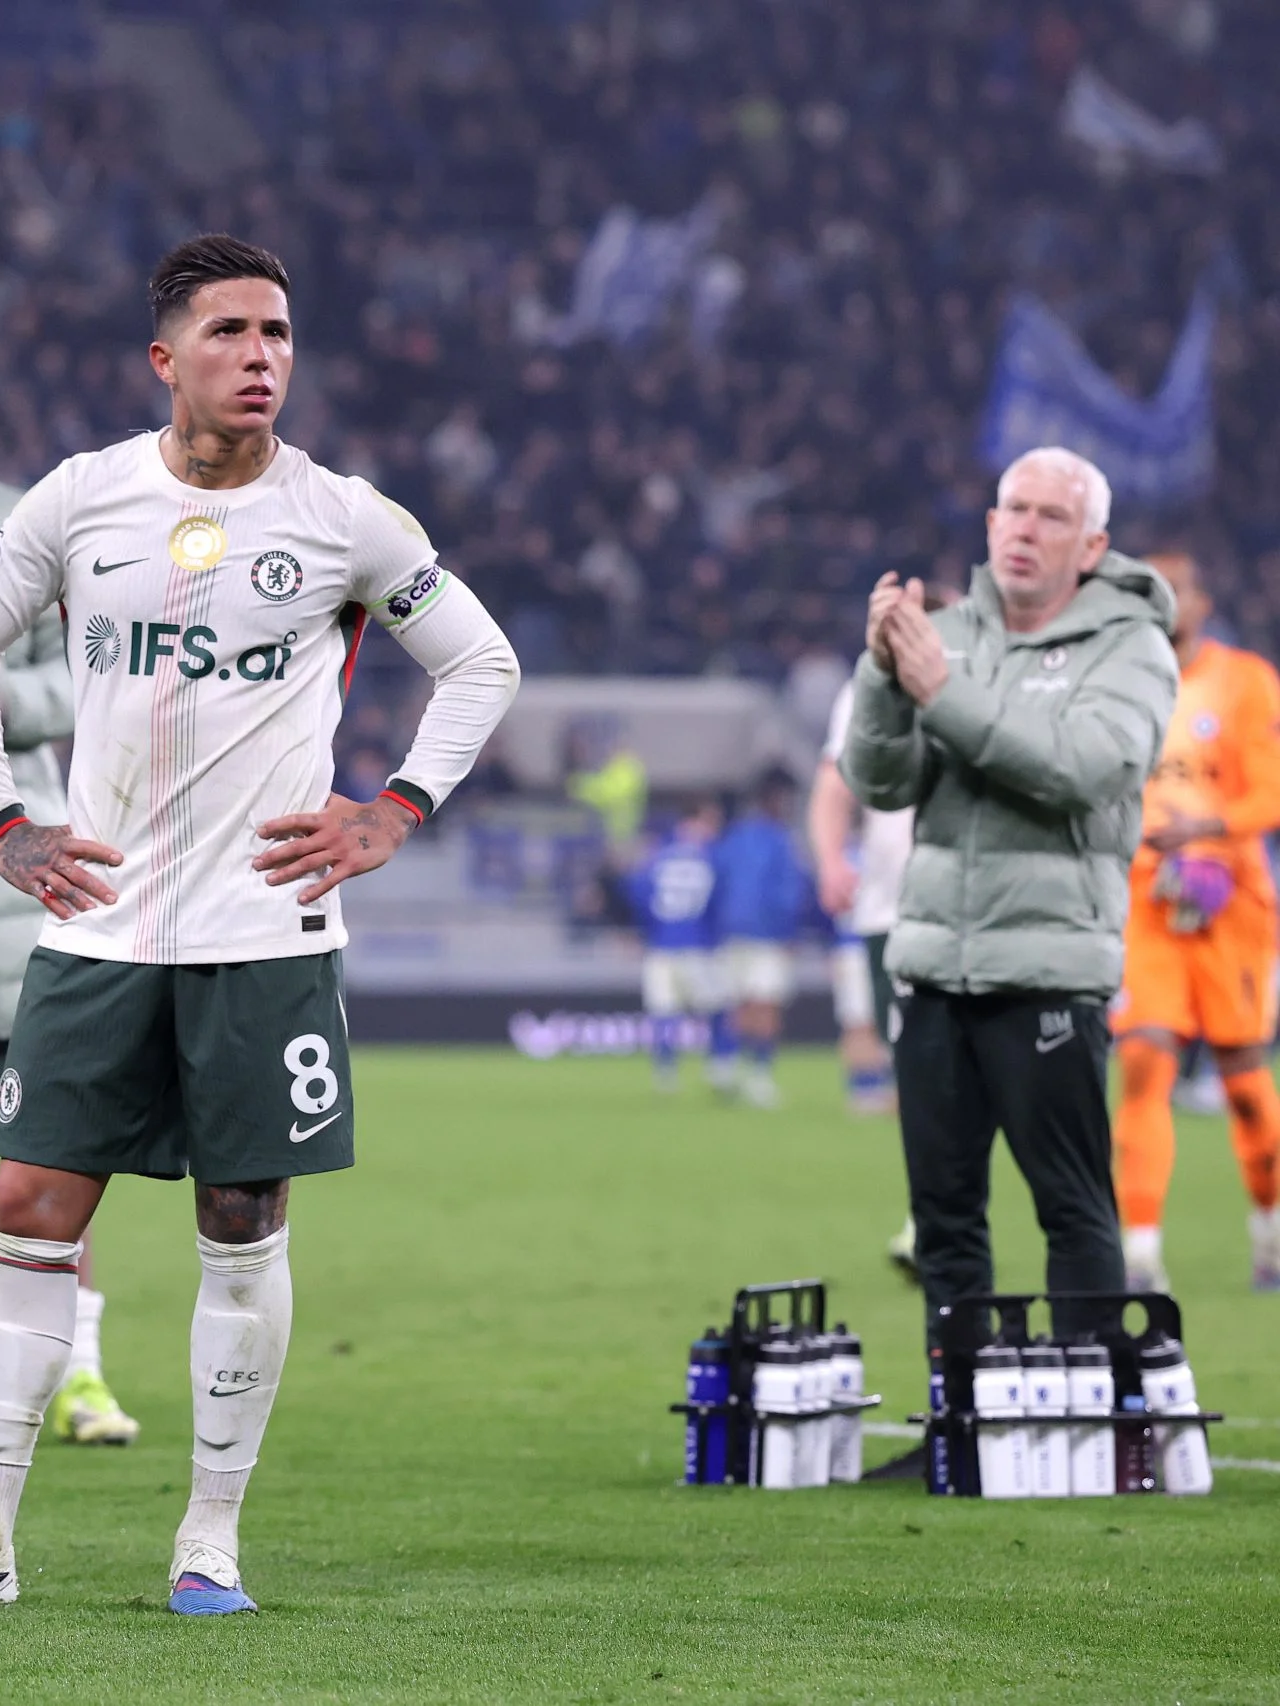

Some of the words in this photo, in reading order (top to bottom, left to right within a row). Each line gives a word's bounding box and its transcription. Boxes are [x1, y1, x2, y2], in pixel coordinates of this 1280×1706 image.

[261, 552, 297, 566] CHELSEA
[129, 621, 298, 681] IFS.ai
[283, 1033, 339, 1115] 8
[217, 1370, 260, 1383] CFC
